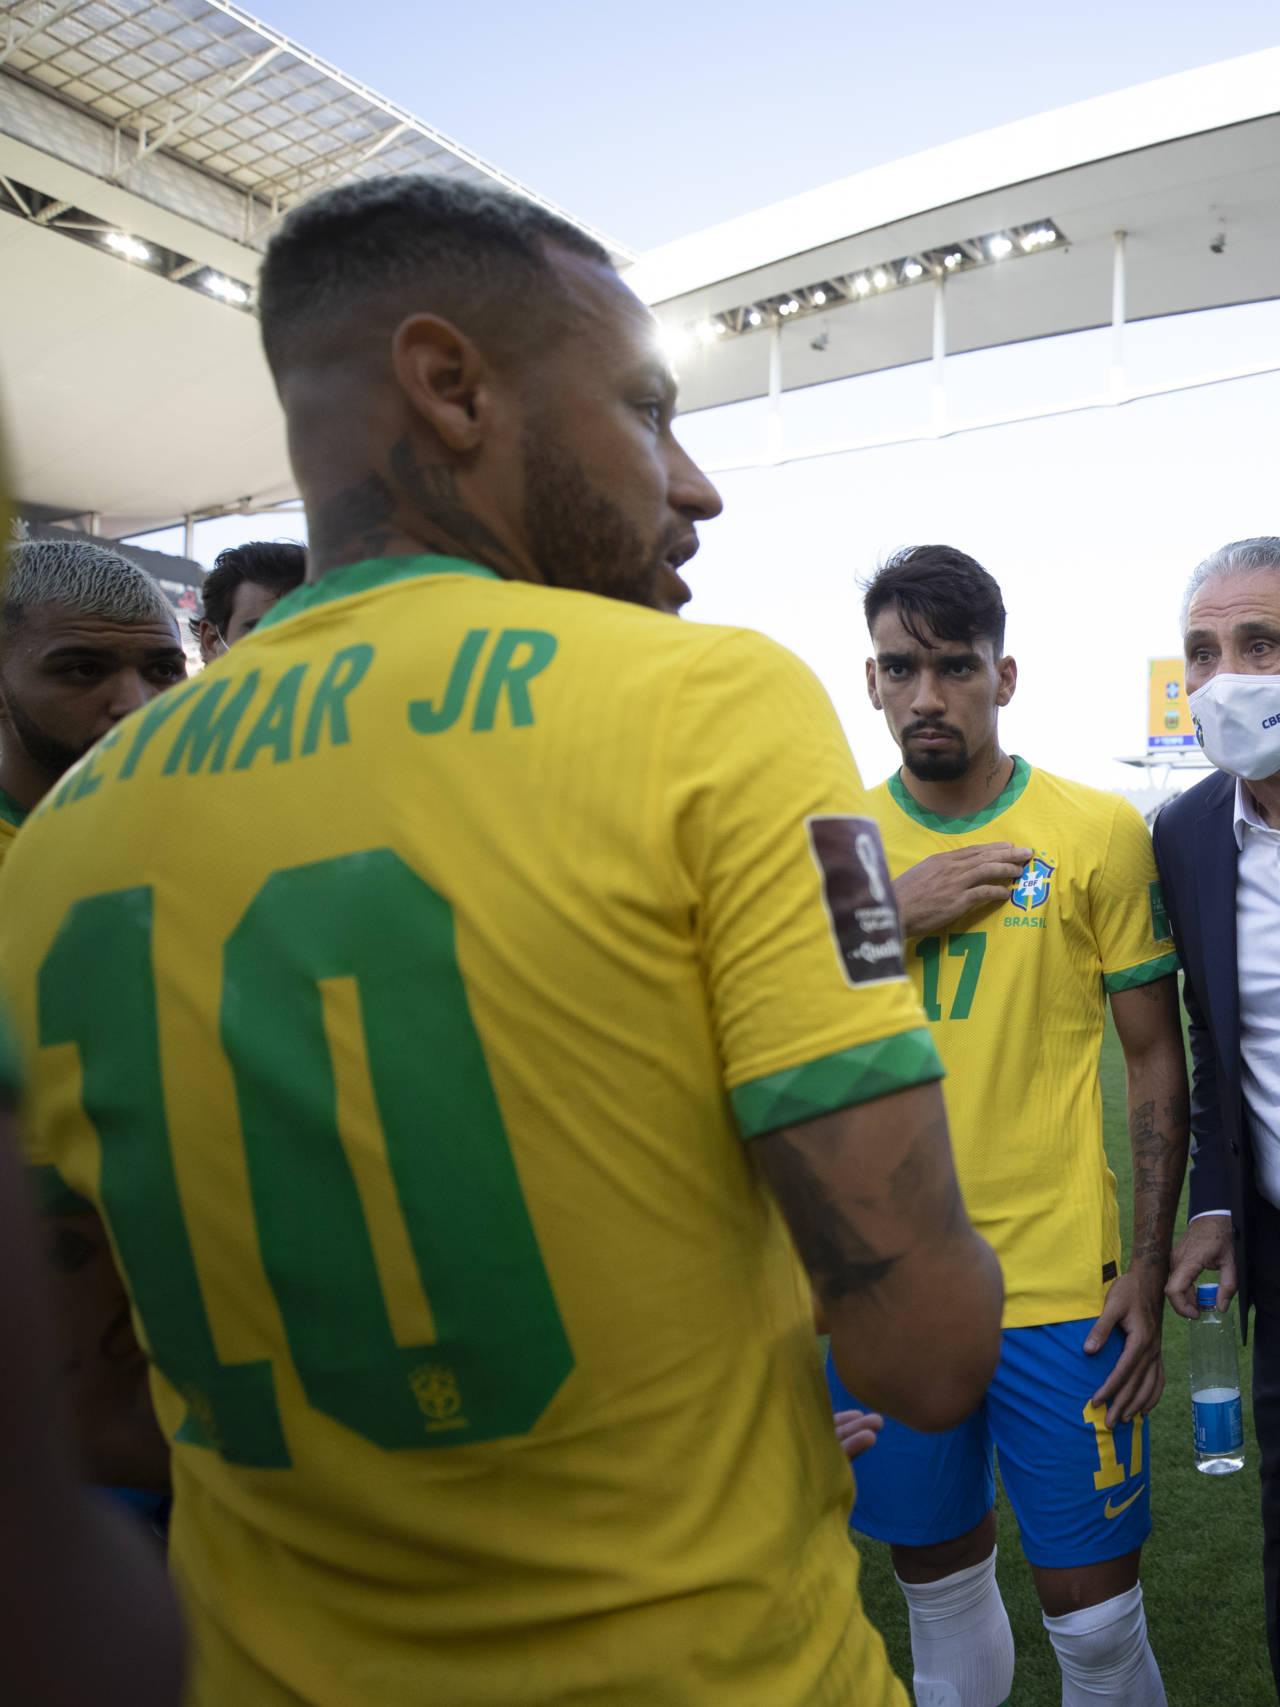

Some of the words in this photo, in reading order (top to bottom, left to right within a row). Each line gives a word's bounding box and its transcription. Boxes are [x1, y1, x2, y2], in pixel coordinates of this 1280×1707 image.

[407, 628, 559, 735] JR
[1003, 916, 1047, 929] BRASIL
[1022, 879, 1038, 888] CBF
[915, 931, 987, 1022] 17
[37, 847, 576, 1470] 10
